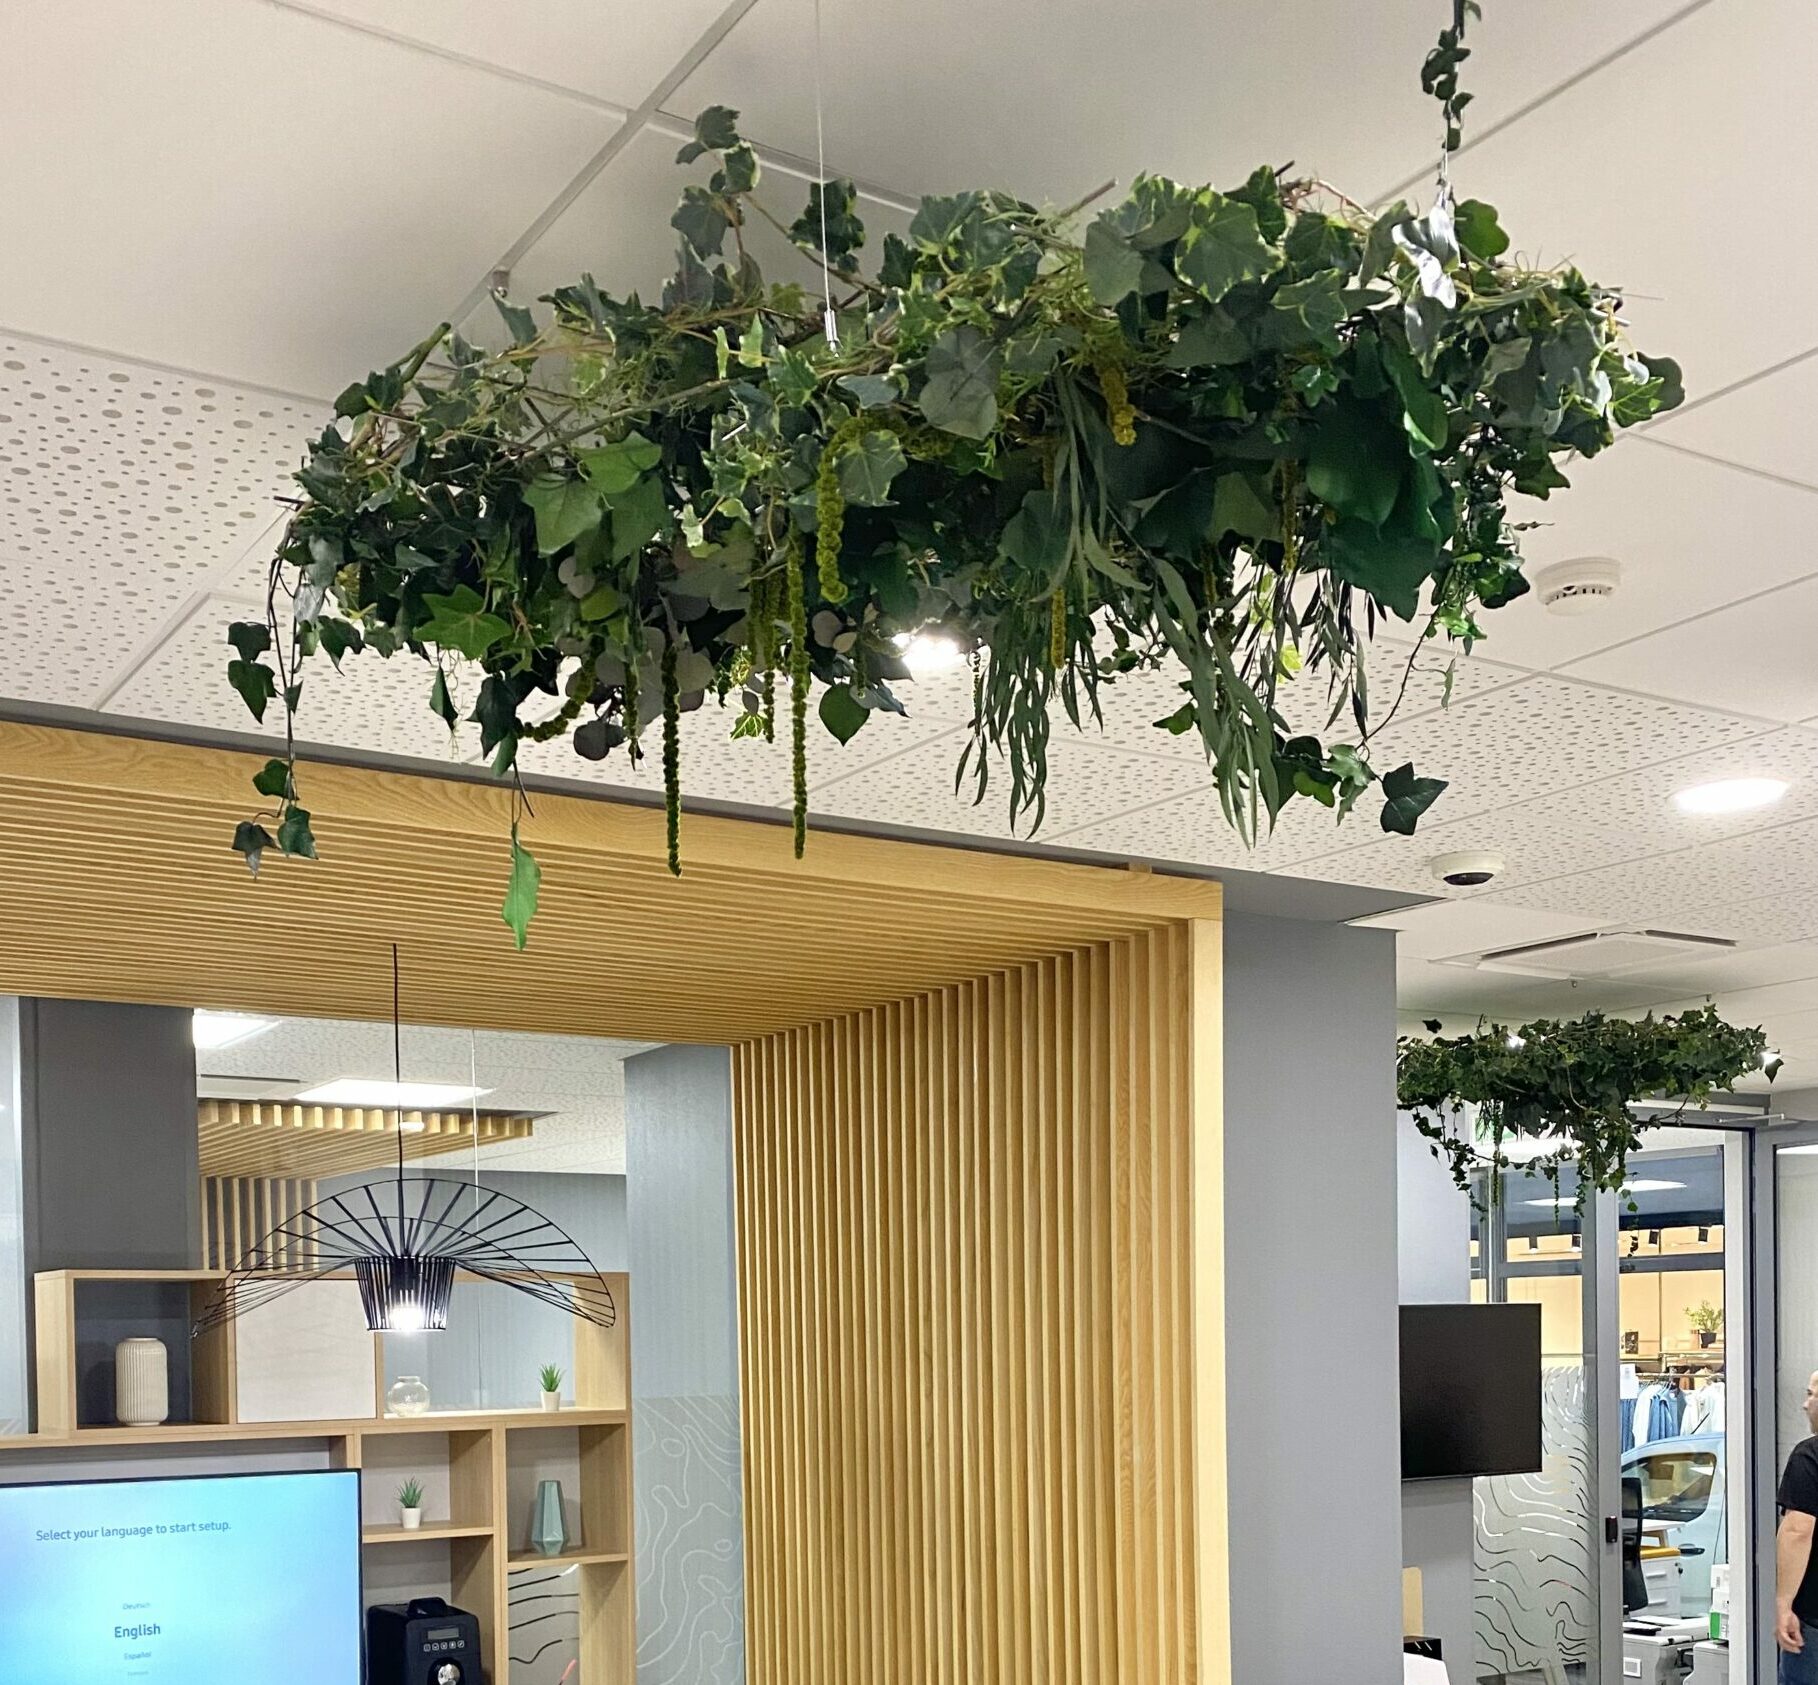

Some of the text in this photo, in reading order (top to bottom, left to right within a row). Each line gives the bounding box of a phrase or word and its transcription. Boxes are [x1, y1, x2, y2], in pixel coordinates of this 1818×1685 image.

[36, 1520, 232, 1542] Select your language to start setup.
[114, 1623, 161, 1640] English
